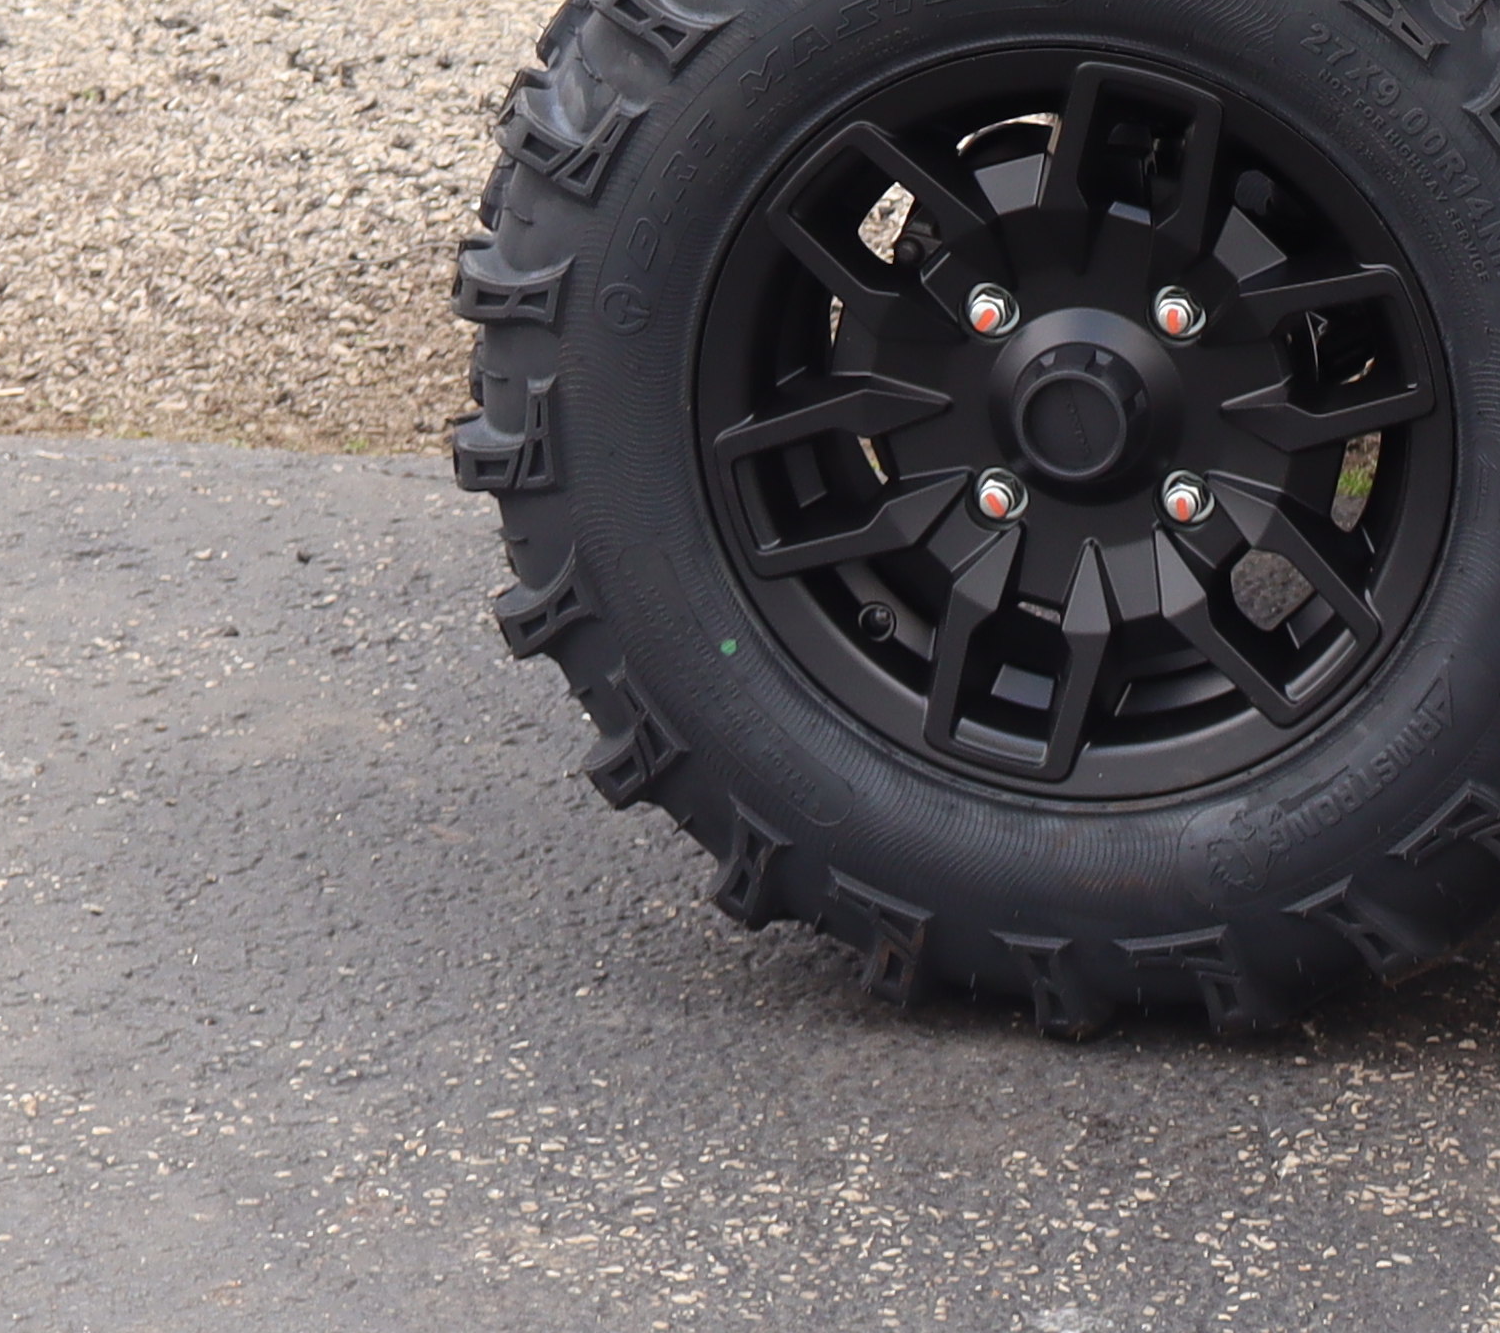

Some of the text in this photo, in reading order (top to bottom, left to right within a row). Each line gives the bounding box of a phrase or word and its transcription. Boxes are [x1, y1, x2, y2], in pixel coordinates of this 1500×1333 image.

[625, 108, 722, 271] DIRT
[1315, 66, 1353, 99] NOT
[1351, 95, 1387, 129] FOR
[1383, 125, 1449, 206] HIGHWAY
[1442, 203, 1491, 286] SERVICE
[1265, 670, 1452, 857] ARMSTRONG
